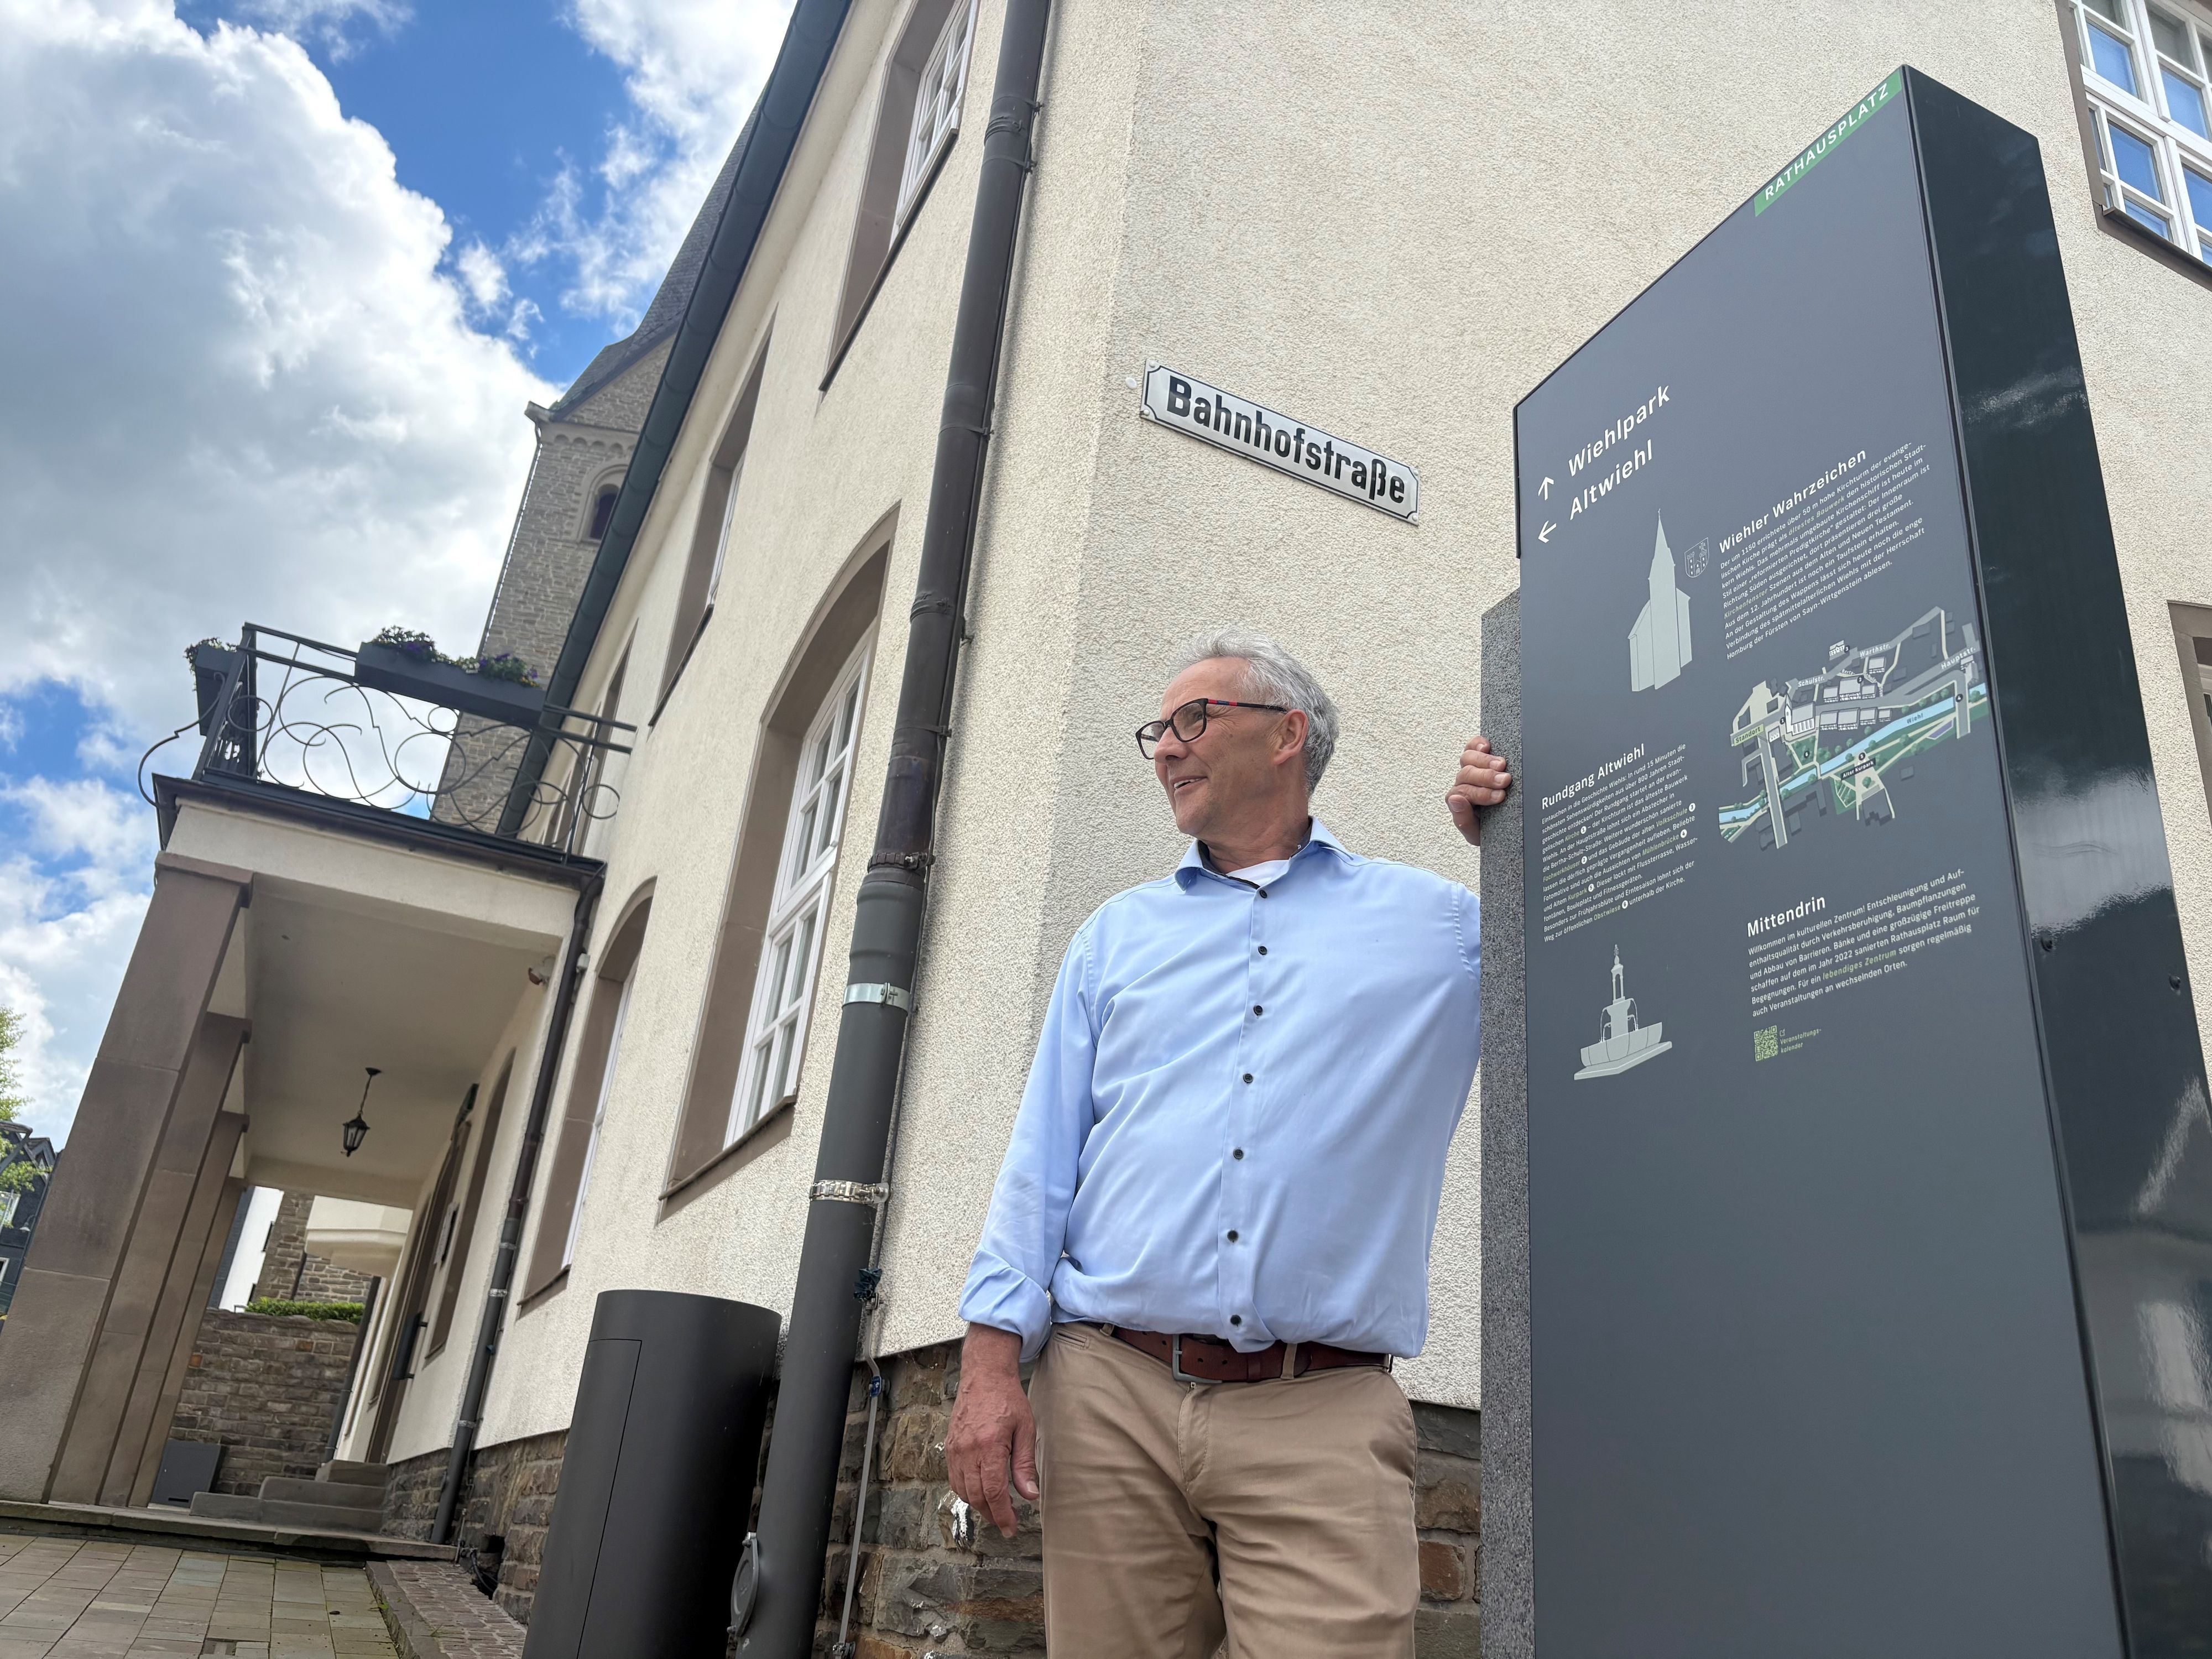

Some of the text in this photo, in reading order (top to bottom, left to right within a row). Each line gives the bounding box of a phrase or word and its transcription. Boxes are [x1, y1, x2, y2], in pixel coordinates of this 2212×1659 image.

[1764, 82, 1890, 201] RATHAUSPLATZ
[1166, 375, 1405, 504] Bahnhofstraße
[1567, 384, 1670, 478] Wiehlpark
[1569, 439, 1653, 521] Altwiehl
[1719, 450, 1866, 554] Wiehler Wahrzeichen
[1720, 559, 1730, 569] Der
[1731, 553, 1740, 562] um
[1741, 542, 1756, 556] 1150
[1757, 523, 1786, 545] errichtete
[1787, 513, 1801, 525] über
[1802, 506, 1811, 515] 50
[1819, 491, 1835, 505] hohe
[1837, 469, 1869, 494] Kirchturm
[1870, 460, 1881, 471] der
[1884, 442, 1912, 463] evange-
[1721, 457, 1923, 589] kern Wiehls. Das mehrmals umgebaute Kirchenschiff ist heute im
[1723, 494, 1902, 609] Richtung Süden ausgerichtet, dort präsentieren drei große
[1725, 521, 1899, 629] Aus dem 12. Jahrhundert ist noch ein Taufstein erhalten.
[1726, 528, 1924, 649] Verbindung des spätmittelalterlichen Wiehls mit der Herrschaft
[1727, 561, 1892, 660] Homburg der Fürsten von Sayn-Wittgenstein ablesen.
[1798, 675, 1825, 687] Schulstr.
[1859, 643, 1891, 658] Warthstr.
[1941, 646, 1976, 669] Hauptstr.
[1735, 726, 1761, 744] Standort
[1907, 713, 1924, 724] Wiehl
[1542, 743, 1645, 810] Rundgang Altwiehl
[1542, 755, 1685, 834] schönsten Sehenswürdigkeiten aus über 800 Jahren Stadt-
[1542, 827, 1567, 845] geschichte
[1567, 812, 1594, 830] entdecken!
[1594, 808, 1603, 817] Der
[1604, 795, 1629, 812] Rundgang
[1629, 785, 1647, 799] startet
[1656, 776, 1665, 785] der
[1666, 769, 1682, 779] evan-
[1843, 760, 1874, 778] Alter Kurpark
[1543, 881, 1558, 893] lassen
[1567, 868, 1585, 881] dörflich
[1586, 857, 1609, 873] geprägte
[1609, 838, 1646, 860] Vergangenheit
[1647, 827, 1672, 843] aufleben.
[1672, 816, 1695, 831] Beliebte
[1551, 839, 1603, 869] Bertha-Schulz-Straße:
[1603, 829, 1623, 843] Weitere
[1624, 811, 1659, 832] wunderschön
[1660, 800, 1682, 815] sanierte
[1543, 874, 1642, 922] fontänen, Bouleplatz und Fitnessgeräten.
[1544, 917, 1569, 932] Besonders
[1578, 897, 1614, 917] Frühjahrsblüte
[1614, 891, 1624, 901] und
[1625, 878, 1656, 896] Erntesaison
[1657, 870, 1671, 882] lohnt
[1672, 865, 1684, 875] sich
[1685, 860, 1694, 869] der
[1747, 896, 1825, 937] Mittendrin
[1748, 868, 1964, 956] Willkommen im kulturellen Zentrum! Entschleunigung und Auf-
[1749, 883, 1966, 968] enthaltsqualität durch Verkehrsberuhigung, Baumpflanzungen
[1750, 894, 1975, 980] und Abbau von Barrieren. Bänke und eine großzügige Freitreppe
[1751, 906, 1980, 992] schaffen auf dem im Jahr 2022 sanierten Rathausplatz Raum für
[1751, 924, 1972, 1005] Begegnungen. Für ein lebendiges Zentrum sorgen regelmäßig
[1752, 961, 1907, 1017] auch Veranstaltungen an wechselnden Orten.
[1780, 1029, 1822, 1045] Veranstaltungs-
[1781, 1042, 1803, 1053] kalender
